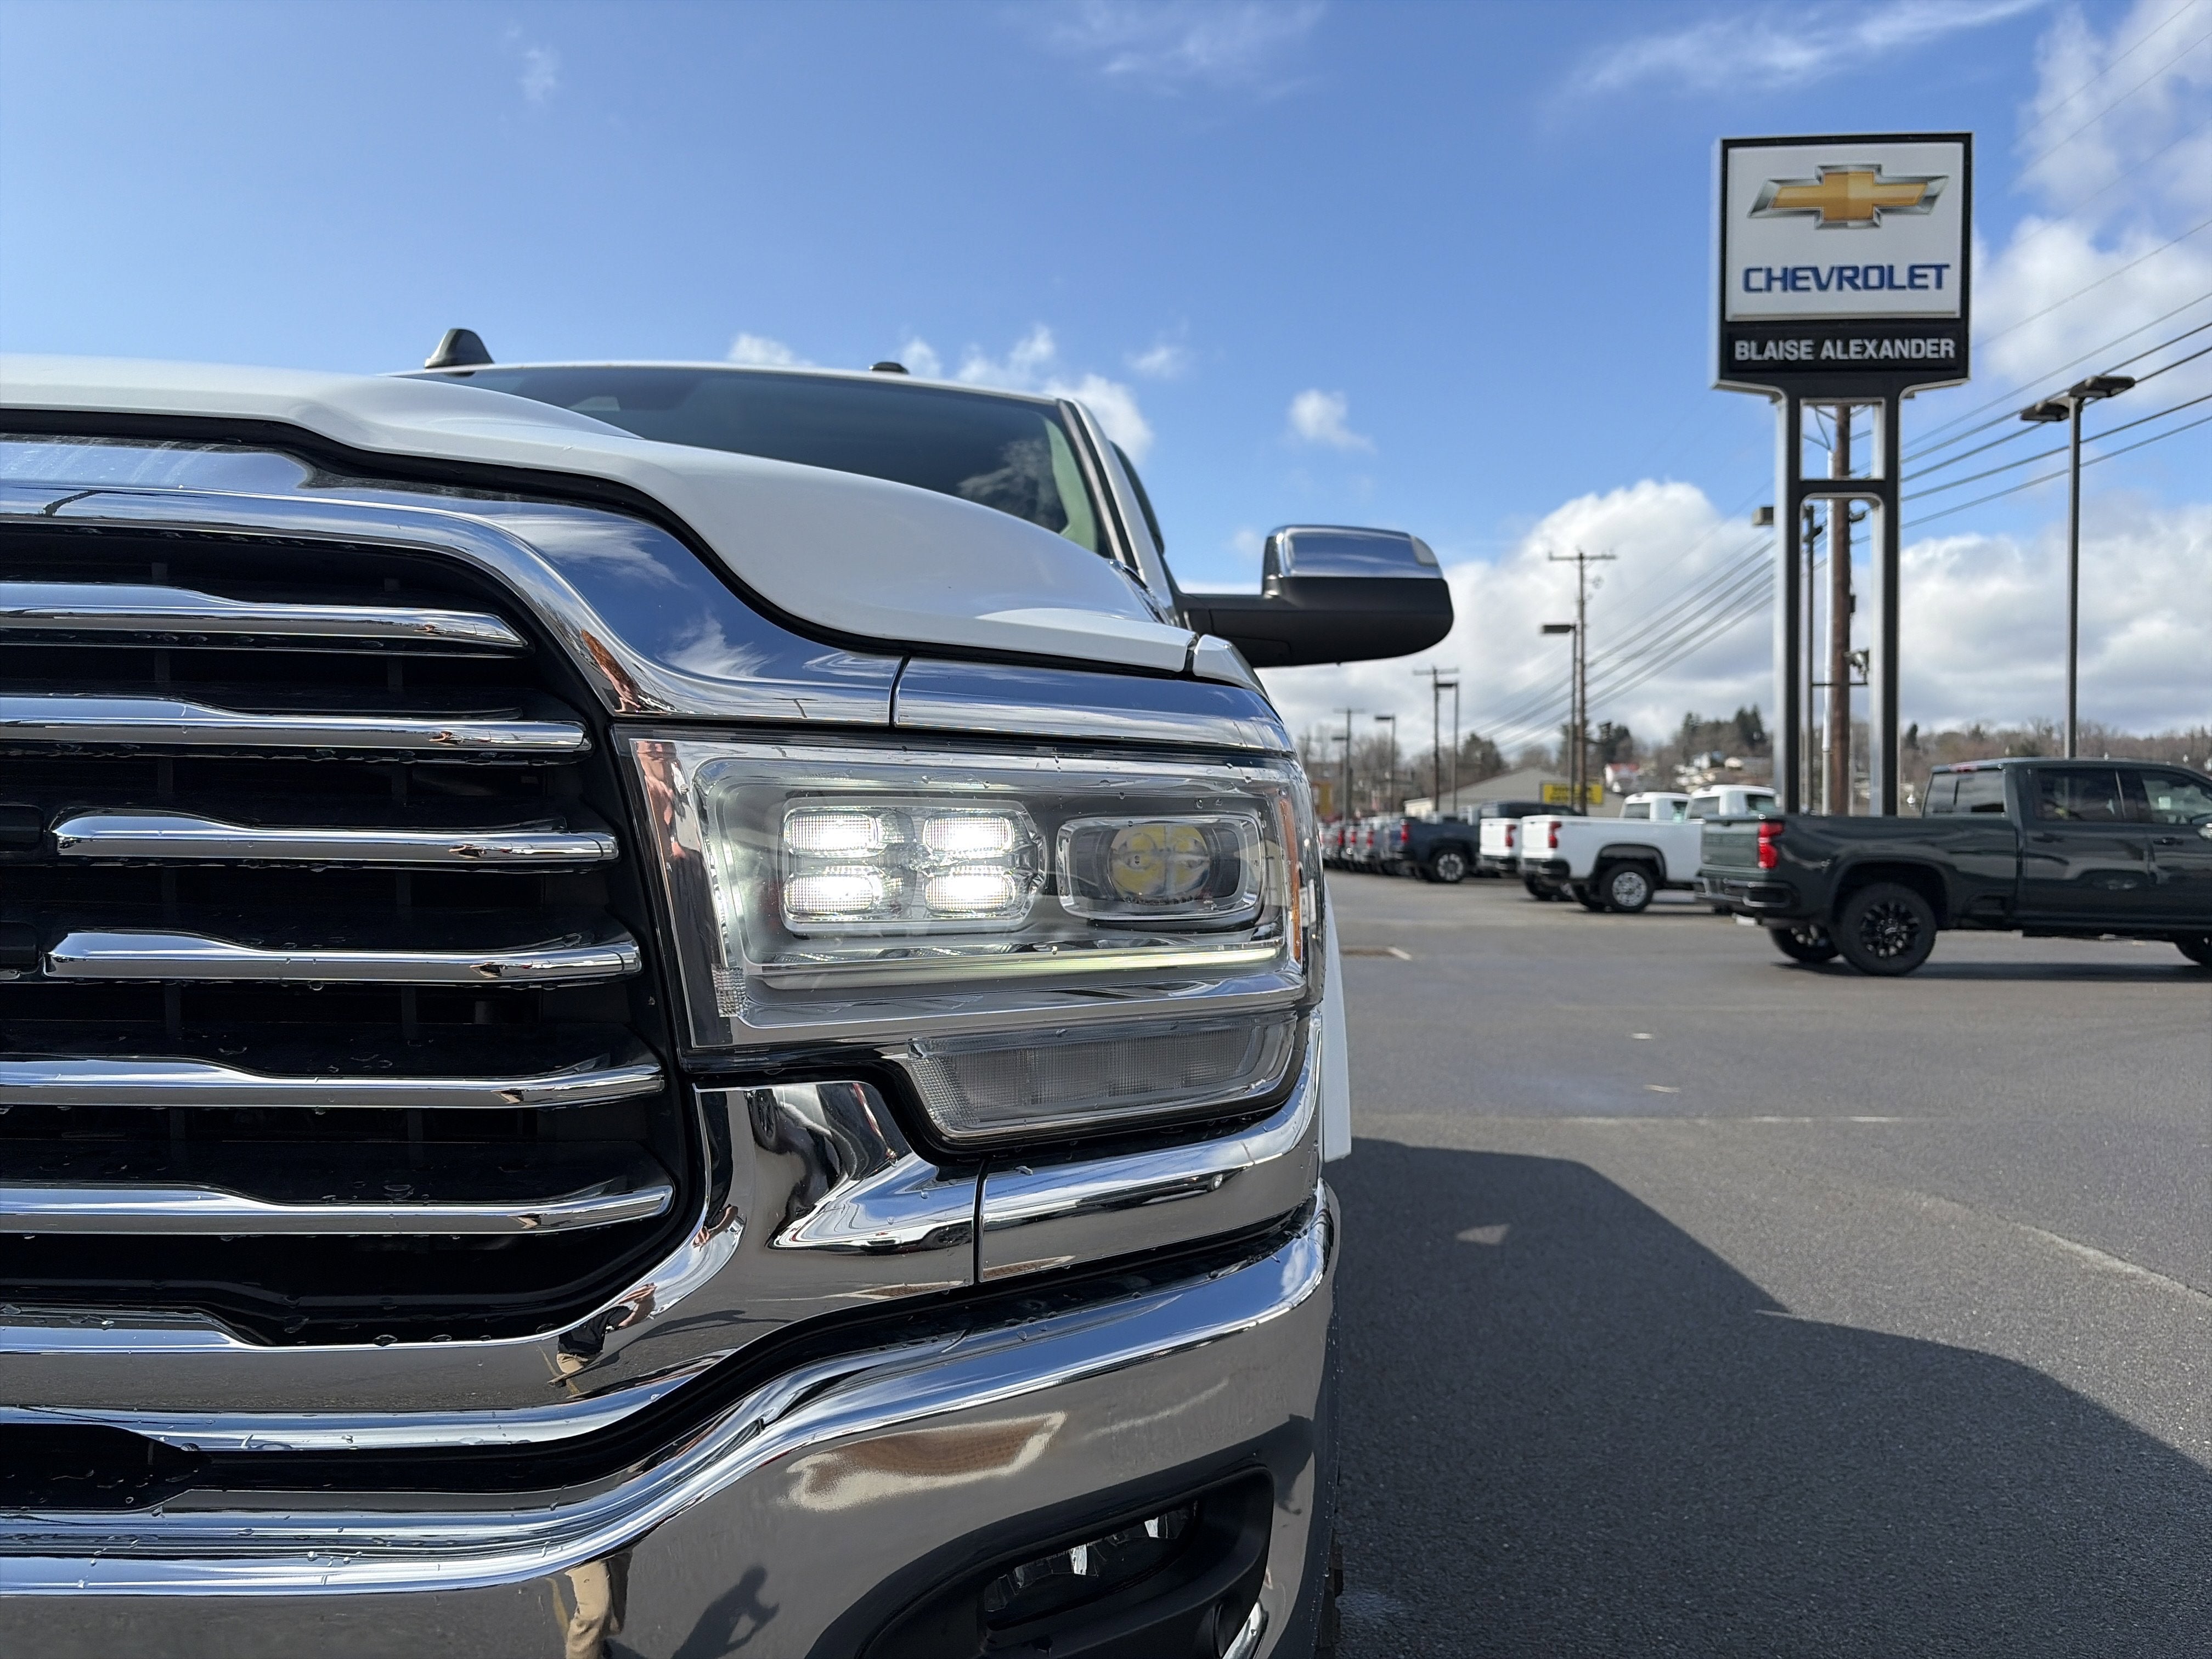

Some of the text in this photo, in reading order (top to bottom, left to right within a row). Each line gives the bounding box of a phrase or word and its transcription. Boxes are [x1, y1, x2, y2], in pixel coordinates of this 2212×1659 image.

[1742, 264, 1950, 293] CHEVROLET
[1735, 338, 1955, 361] BLAISE ALEXANDER
